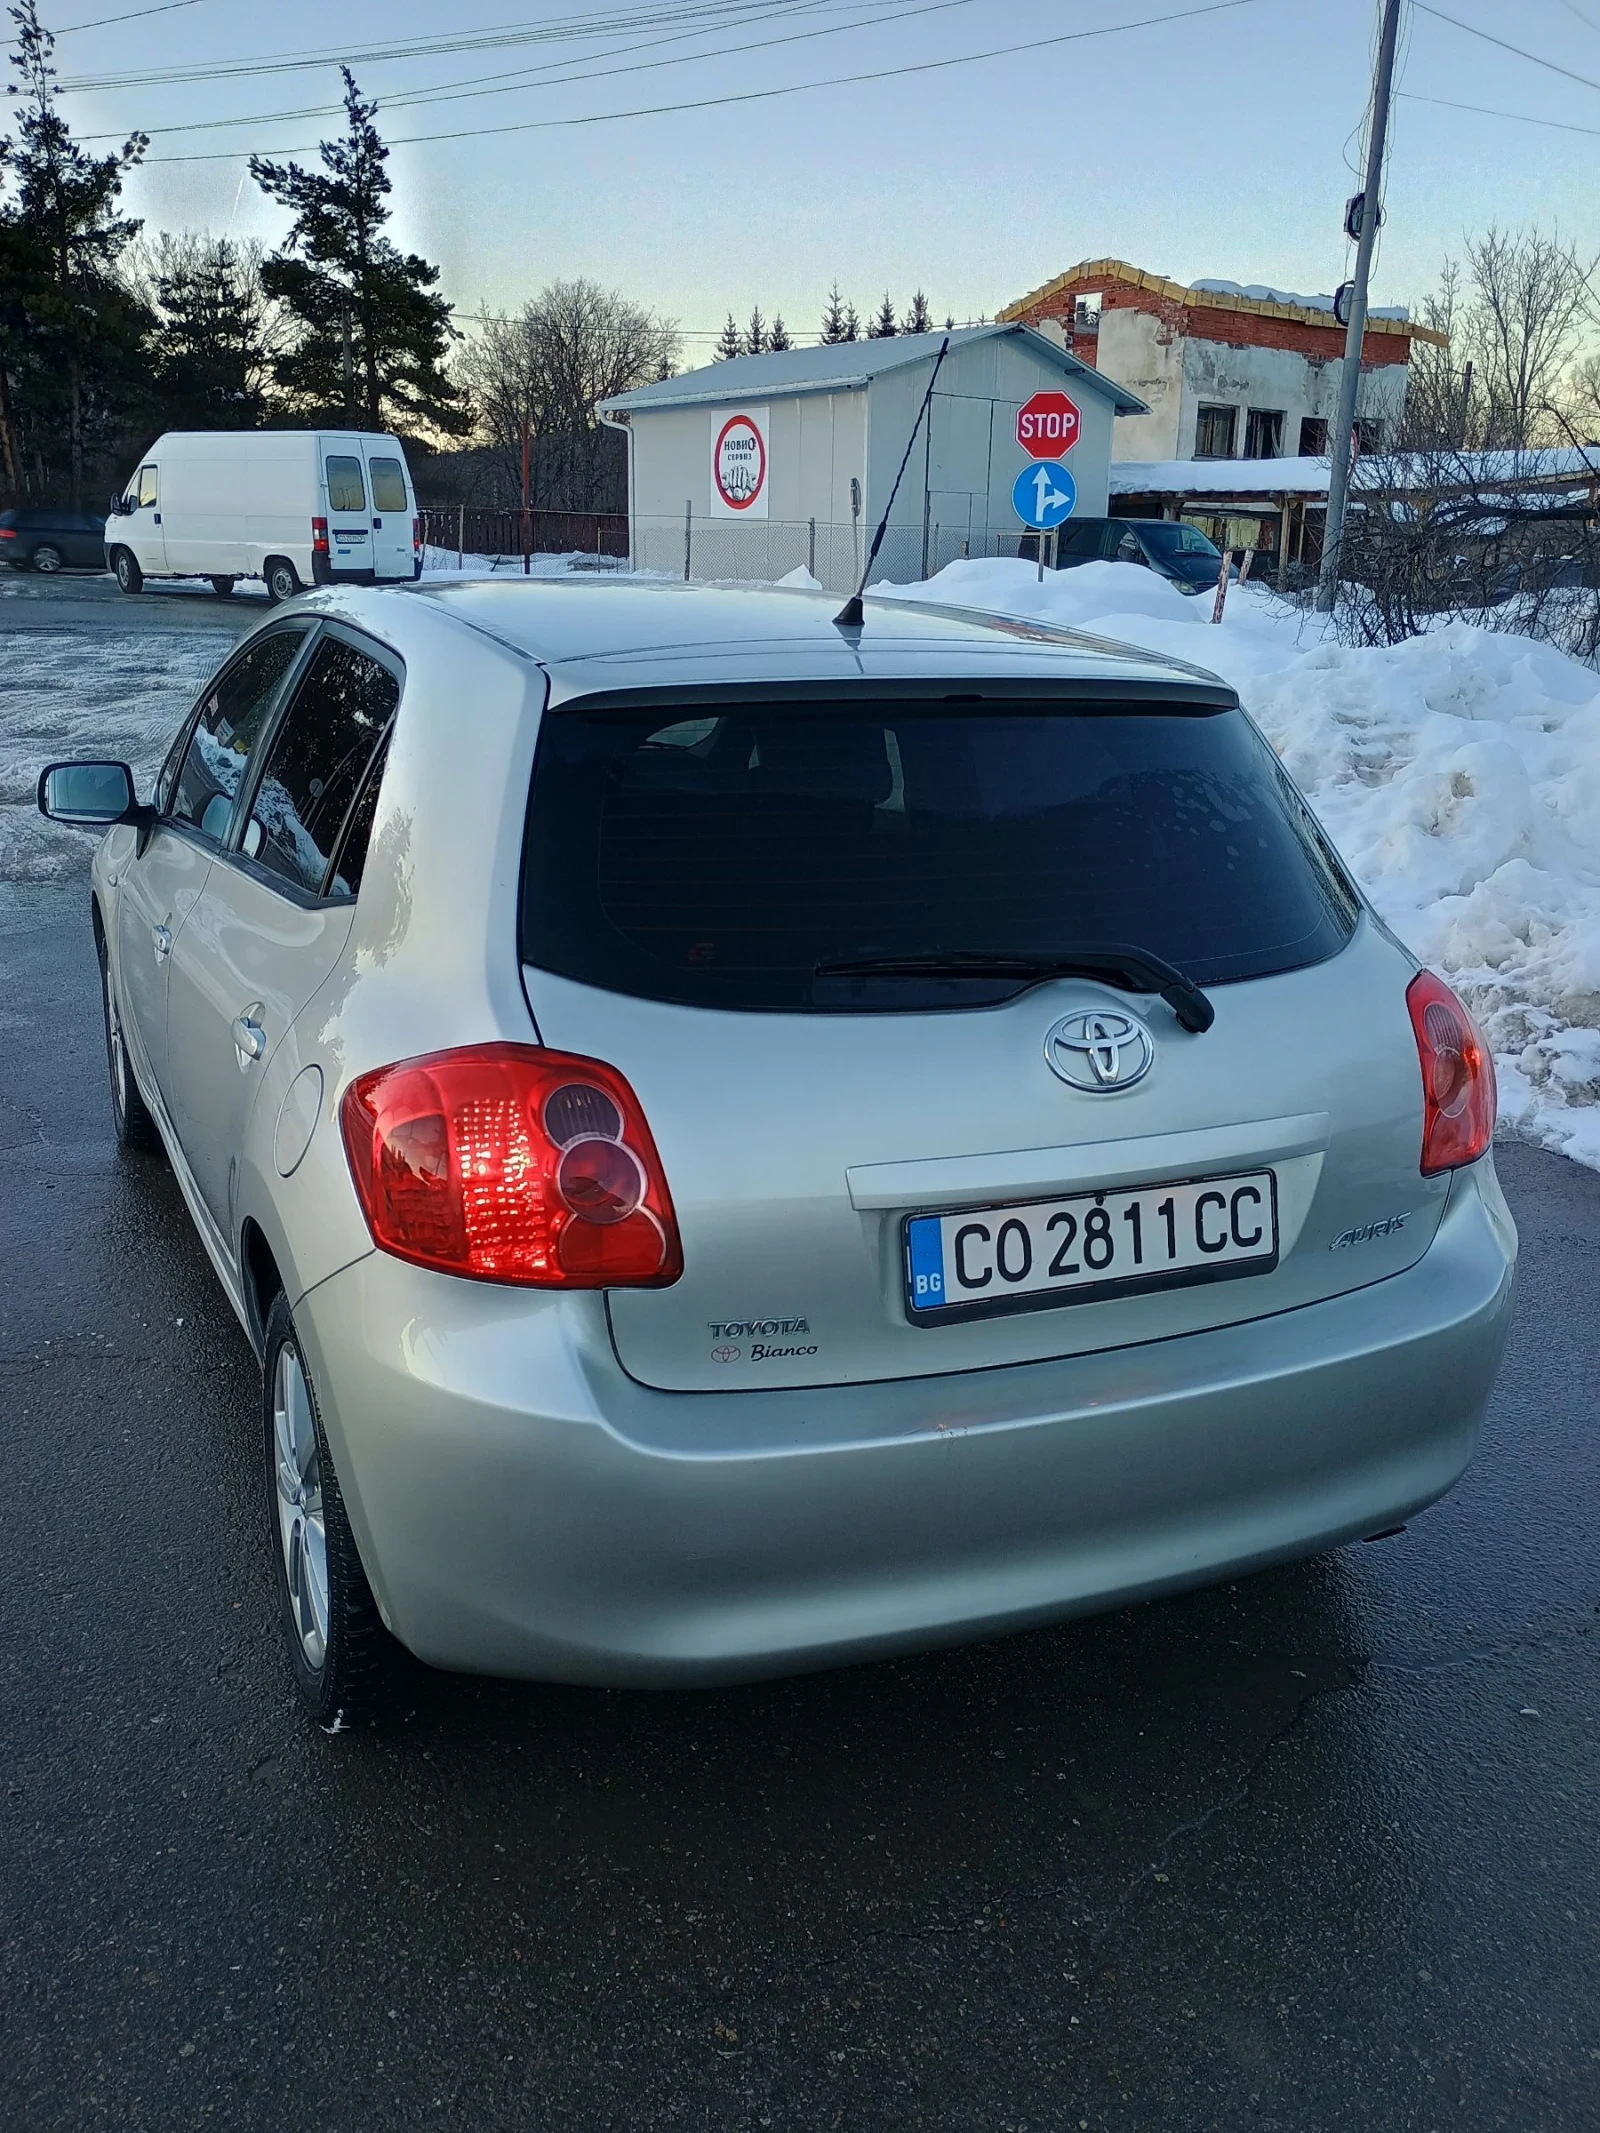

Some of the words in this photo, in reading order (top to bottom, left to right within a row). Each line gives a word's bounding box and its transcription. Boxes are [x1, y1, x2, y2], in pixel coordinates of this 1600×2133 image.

[1020, 412, 1076, 438] STOP
[727, 453, 752, 461] СЕРВИЗ
[1046, 1197, 1176, 1277] 2811
[1195, 1186, 1262, 1253] CC
[1328, 1212, 1411, 1251] AURIS
[916, 1274, 941, 1294] BG
[708, 1316, 810, 1340] TOYOTA
[751, 1344, 819, 1362] Bianco
